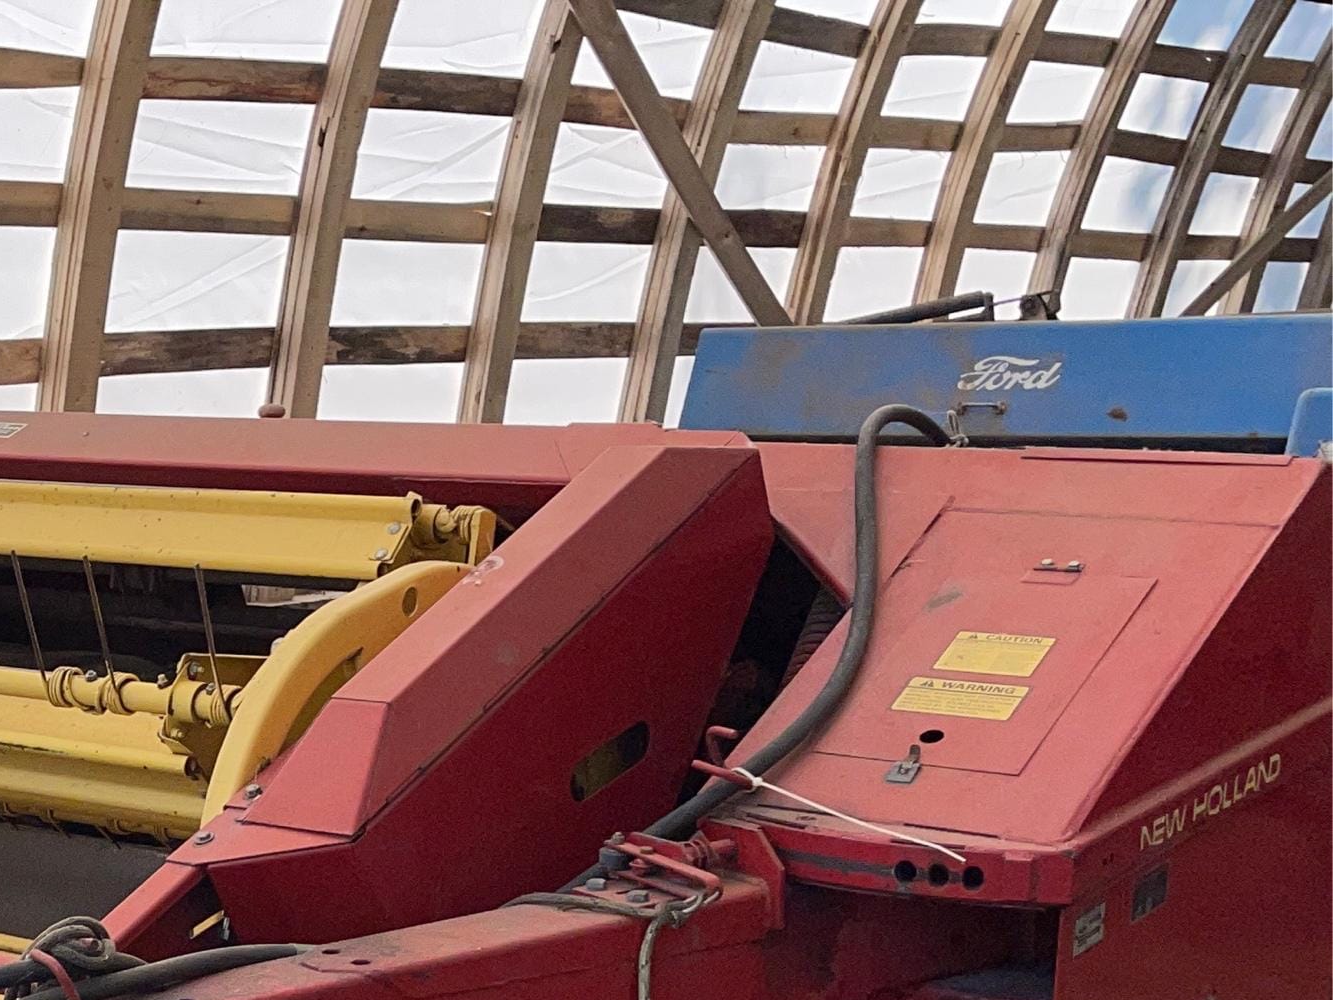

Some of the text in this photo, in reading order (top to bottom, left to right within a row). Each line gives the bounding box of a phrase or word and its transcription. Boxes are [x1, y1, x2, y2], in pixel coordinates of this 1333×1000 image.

[957, 355, 1062, 391] Ford
[985, 634, 1044, 644] CAUTION
[941, 681, 1016, 695] WARNING
[1139, 753, 1281, 851] NEW HOLLAND
